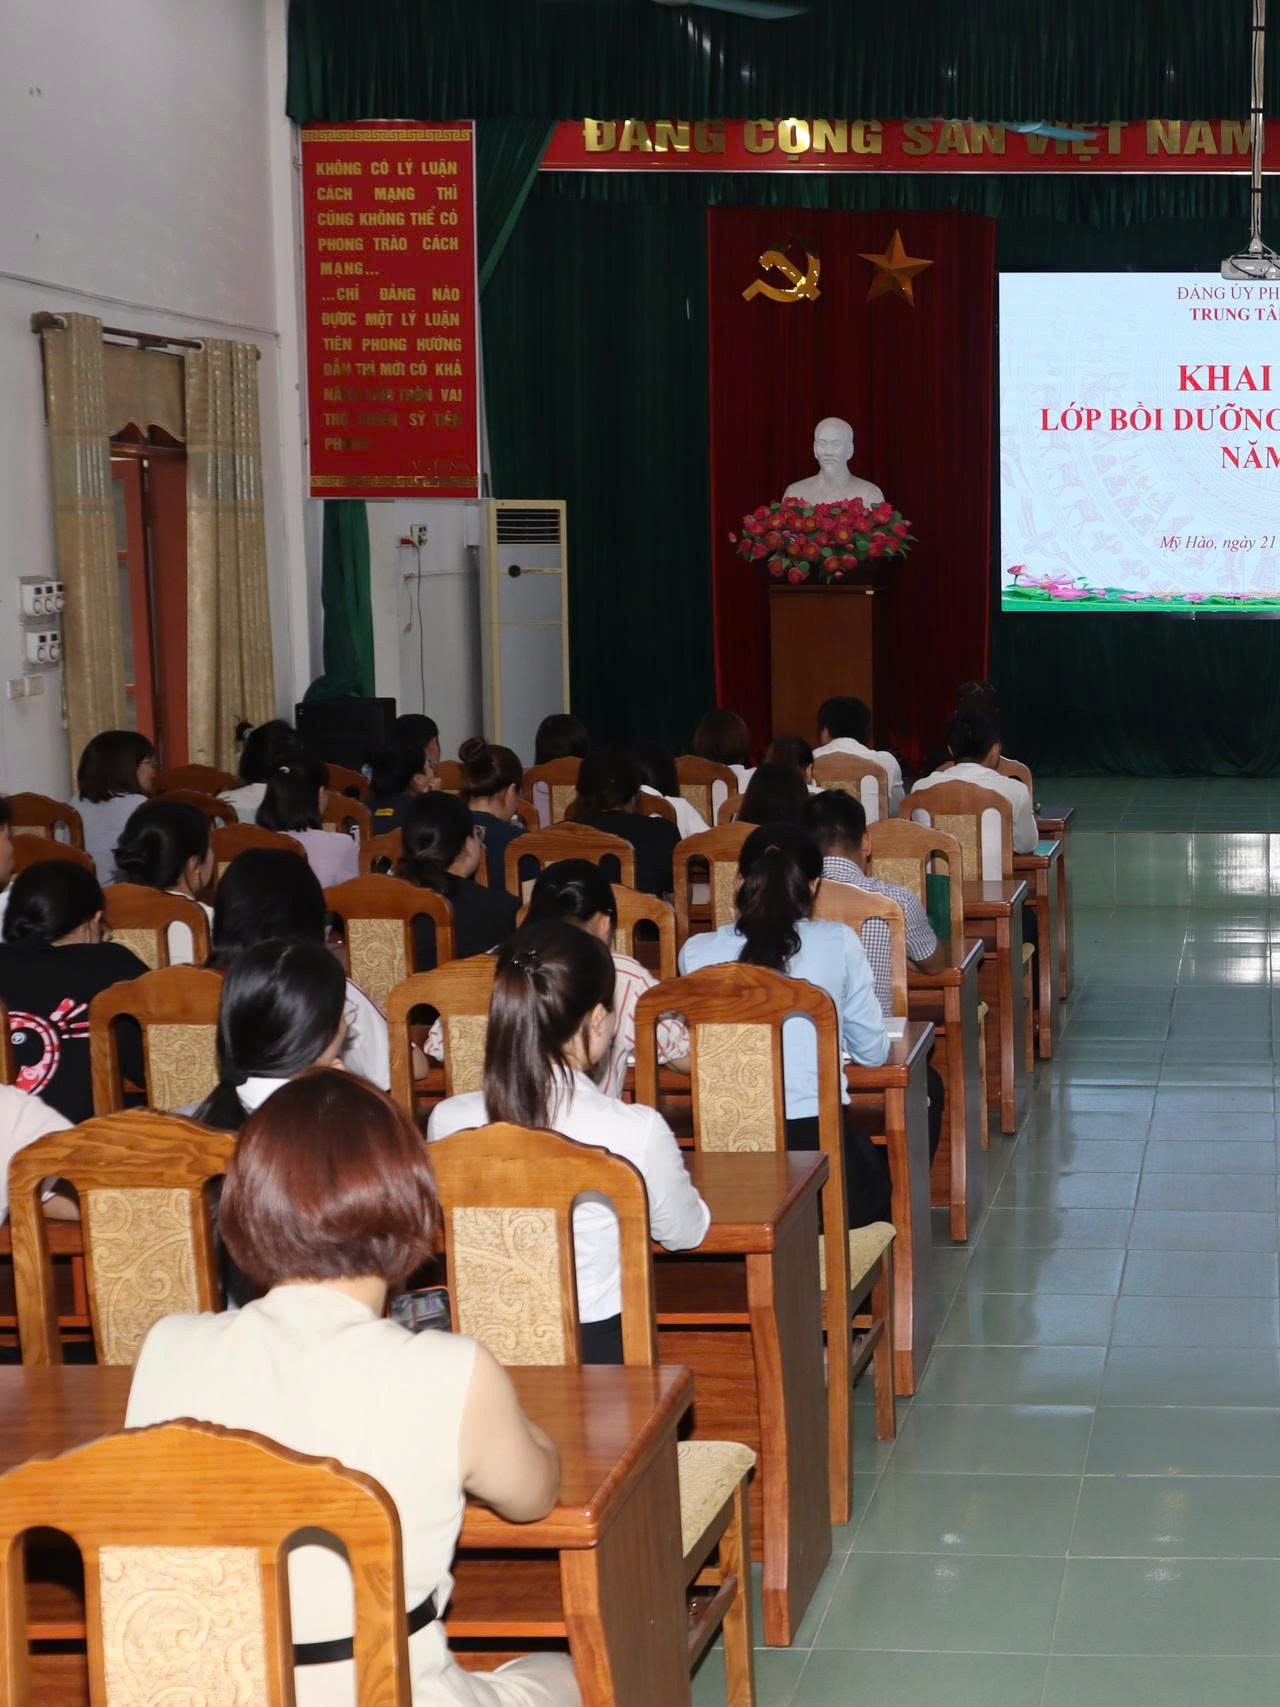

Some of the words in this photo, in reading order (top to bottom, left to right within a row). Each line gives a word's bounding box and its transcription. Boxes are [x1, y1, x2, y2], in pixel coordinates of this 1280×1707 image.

[316, 159, 362, 176] KHÔNG
[370, 158, 389, 176] CÓ
[397, 158, 413, 176] LÝ
[421, 159, 457, 178] LUẬN
[316, 185, 352, 201] CÁCH
[374, 187, 415, 203] MẠNG
[436, 183, 458, 201] THÌ
[317, 209, 354, 226] CŨNG
[359, 209, 405, 226] KHÔNG
[410, 205, 435, 226] THỂ
[440, 208, 458, 226] CÓ
[318, 237, 364, 251] PHONG
[372, 234, 408, 251] TRÀO
[422, 234, 459, 251] CÁCH
[379, 284, 416, 301] ĐẢNG
[432, 284, 460, 301] NÀO
[1177, 283, 1226, 300] ĐẢNG
[1231, 283, 1254, 300] ỦY
[365, 310, 393, 329] MỘT
[401, 309, 417, 326] LÝ
[425, 309, 460, 329] LUẬN
[1189, 307, 1250, 321] TRUNG
[362, 338, 408, 352] PHONG
[416, 334, 462, 352] HƯỚNG
[380, 360, 406, 376] MỚI
[410, 360, 427, 376] CÓ
[435, 358, 462, 376] KHẢ
[1177, 364, 1273, 392] KHAI
[440, 388, 463, 402] VAI
[1040, 401, 1102, 431] LỚP
[1109, 401, 1164, 431] BỒI
[1160, 536, 1182, 552] Mỹ
[1185, 536, 1218, 551] Hào,
[1222, 537, 1256, 552] ngày
[1259, 536, 1275, 549] 21
